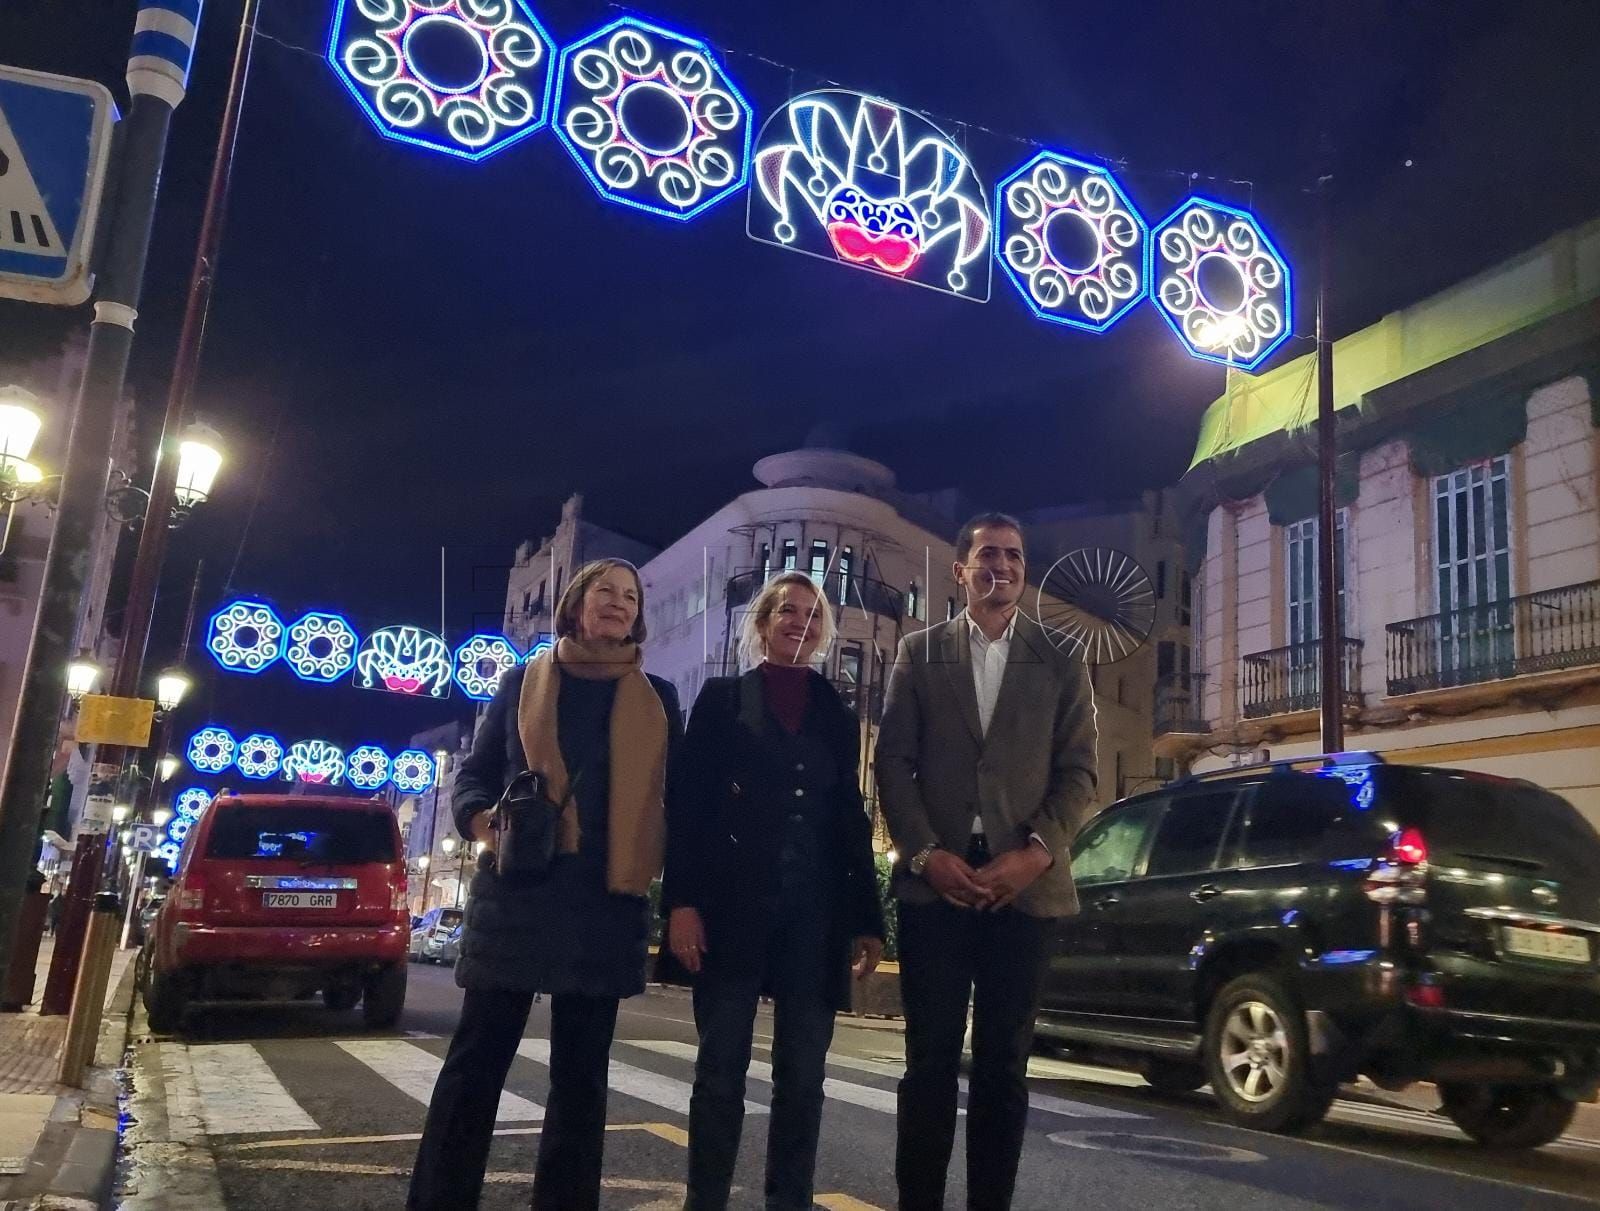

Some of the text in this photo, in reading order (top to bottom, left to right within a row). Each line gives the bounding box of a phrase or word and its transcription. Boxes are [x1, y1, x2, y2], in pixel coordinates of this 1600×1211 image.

[134, 827, 154, 849] R
[270, 894, 333, 907] 7870 GRR
